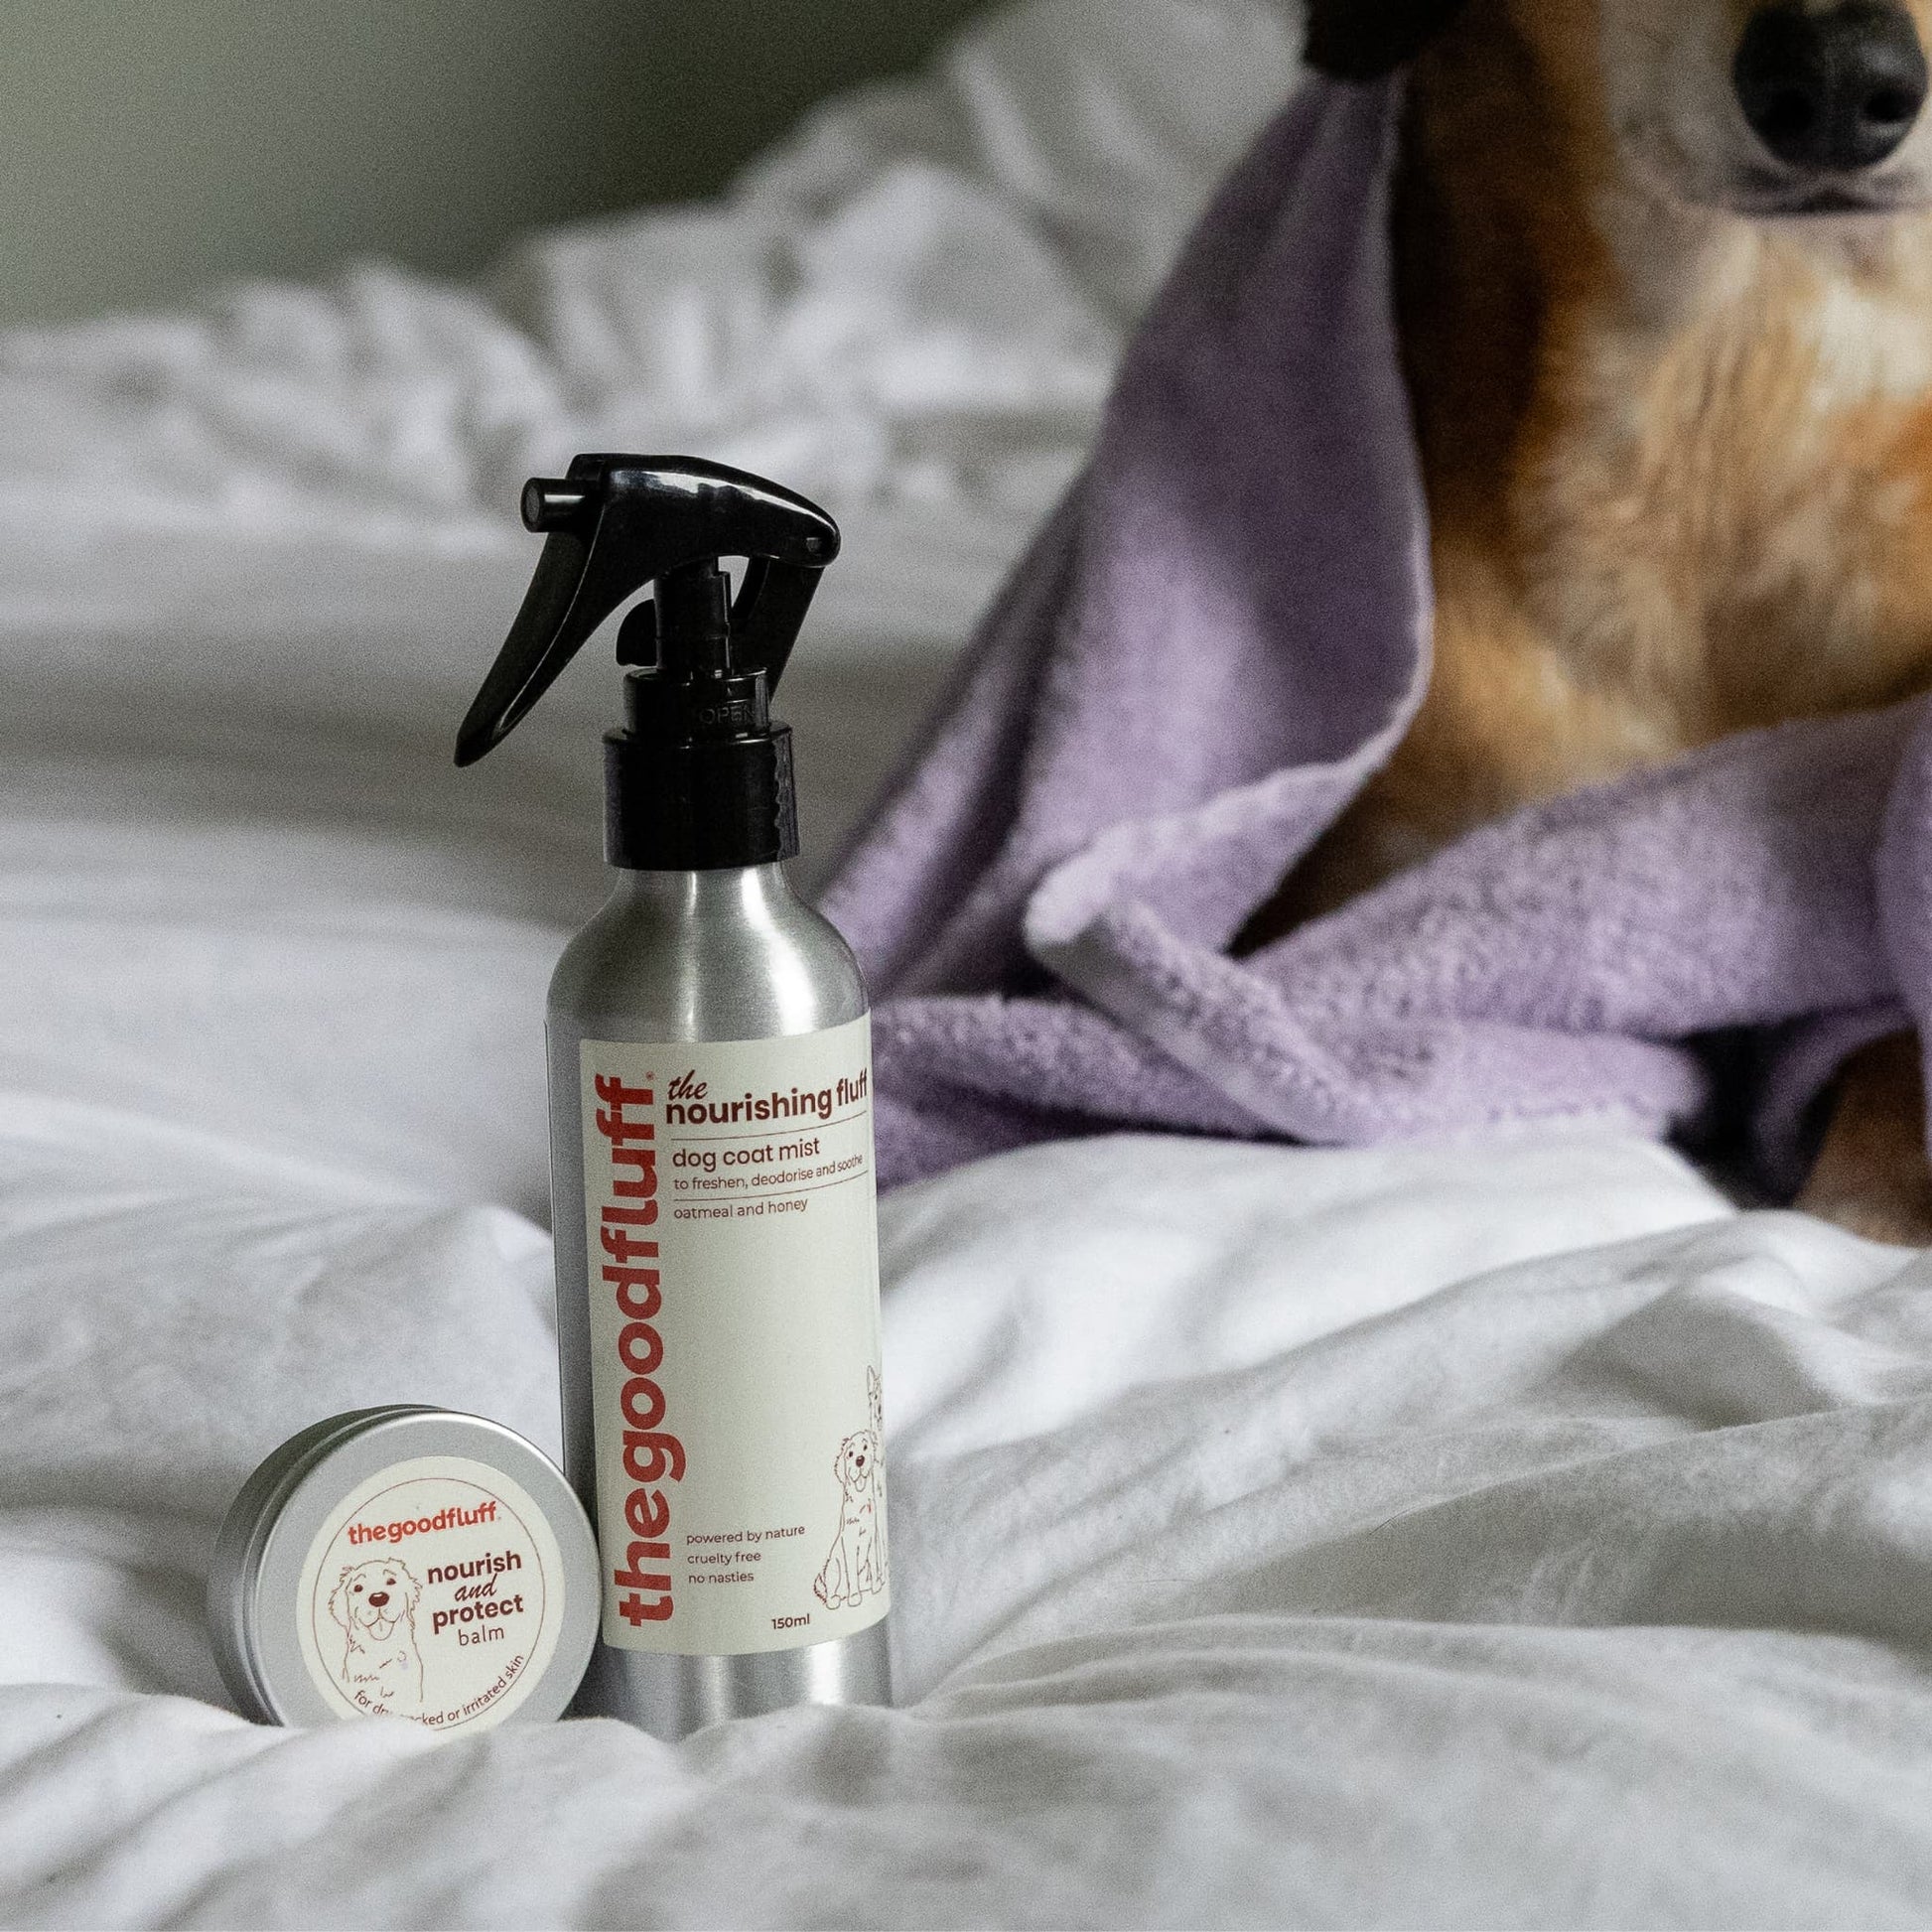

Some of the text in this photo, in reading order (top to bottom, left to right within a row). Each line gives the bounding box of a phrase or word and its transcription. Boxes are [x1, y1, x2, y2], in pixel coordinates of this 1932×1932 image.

[699, 704, 756, 725] OPEN
[666, 1067, 867, 1125] nourishing fluff
[668, 1070, 708, 1101] the
[672, 1138, 820, 1173] dog coat mist
[674, 1154, 863, 1190] to freshen, deodorise and soothe
[674, 1198, 808, 1219] oatmeal and honey
[595, 1073, 687, 1627] thegoodfluff
[348, 1500, 497, 1545] thegoodfluff
[686, 1526, 805, 1546] powered by nature
[428, 1550, 522, 1584] nourish
[687, 1551, 761, 1566] cruelty free
[455, 1574, 497, 1601] and
[688, 1572, 755, 1584] no nasties
[433, 1594, 524, 1634] protect
[771, 1613, 810, 1630] 150ml
[458, 1624, 504, 1646] balm
[354, 1690, 371, 1708] for
[447, 1707, 460, 1722] or
[463, 1676, 506, 1716] irritated
[505, 1655, 524, 1680] skin
